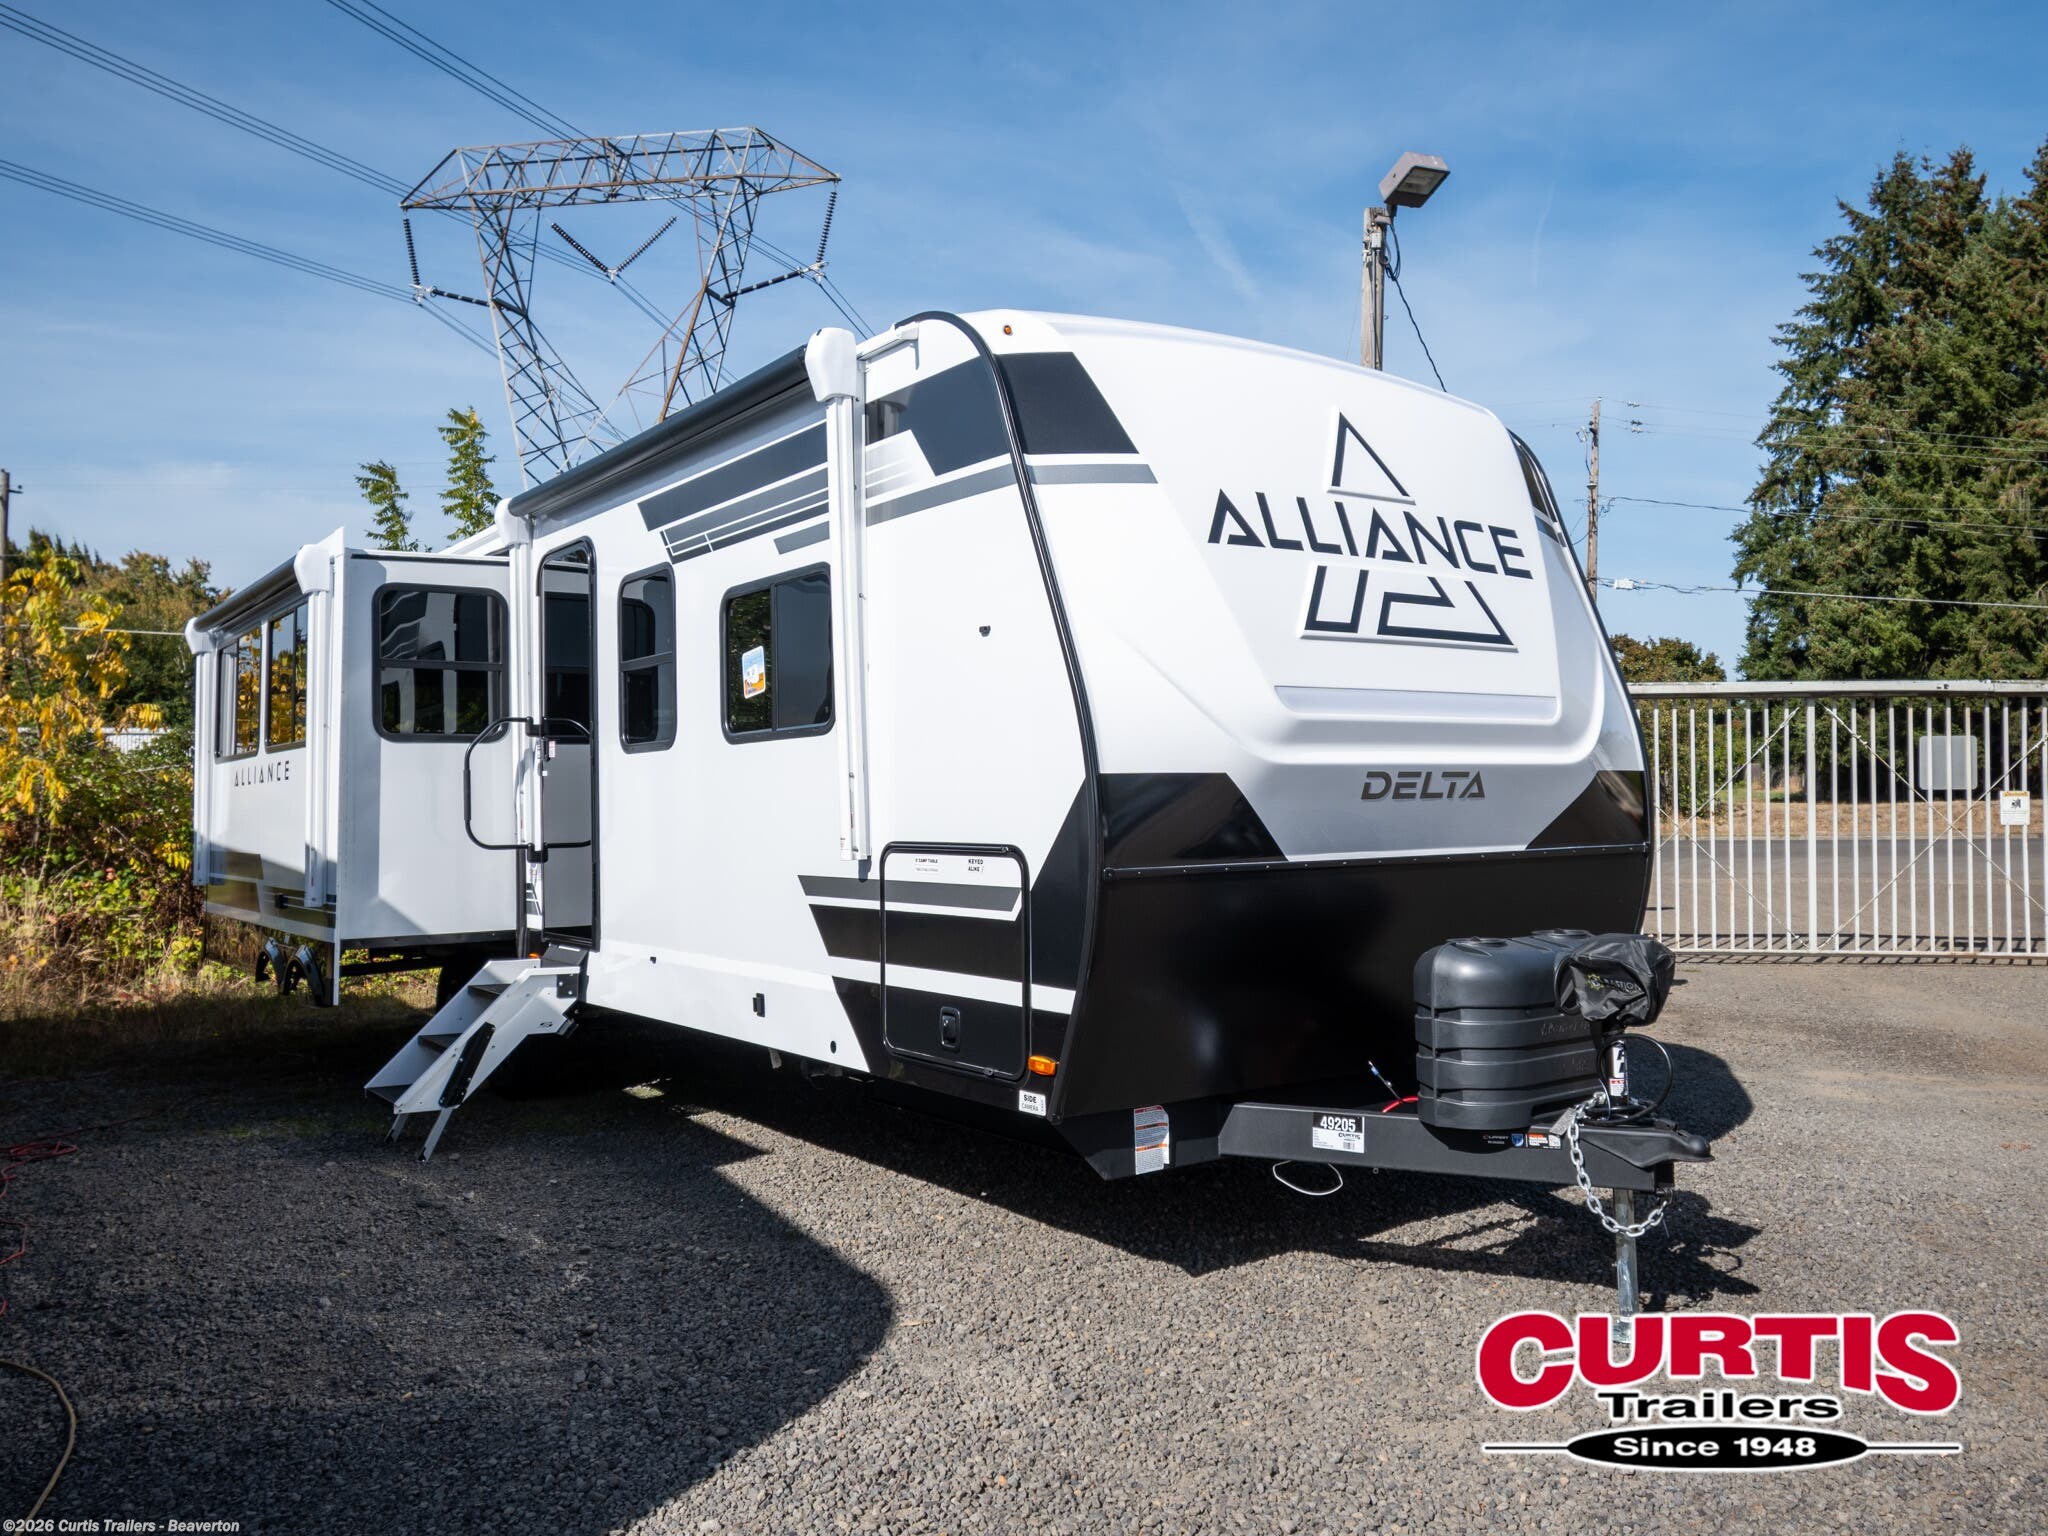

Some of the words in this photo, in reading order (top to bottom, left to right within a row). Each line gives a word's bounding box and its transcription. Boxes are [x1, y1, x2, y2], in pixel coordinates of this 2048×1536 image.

[1207, 488, 1533, 580] ALLIANCE
[234, 760, 290, 787] ALLIANCE
[1361, 771, 1486, 800] DELTA
[1021, 1103, 1039, 1111] CAMERA
[1023, 1094, 1037, 1103] SIDE
[1320, 1115, 1356, 1132] 49205
